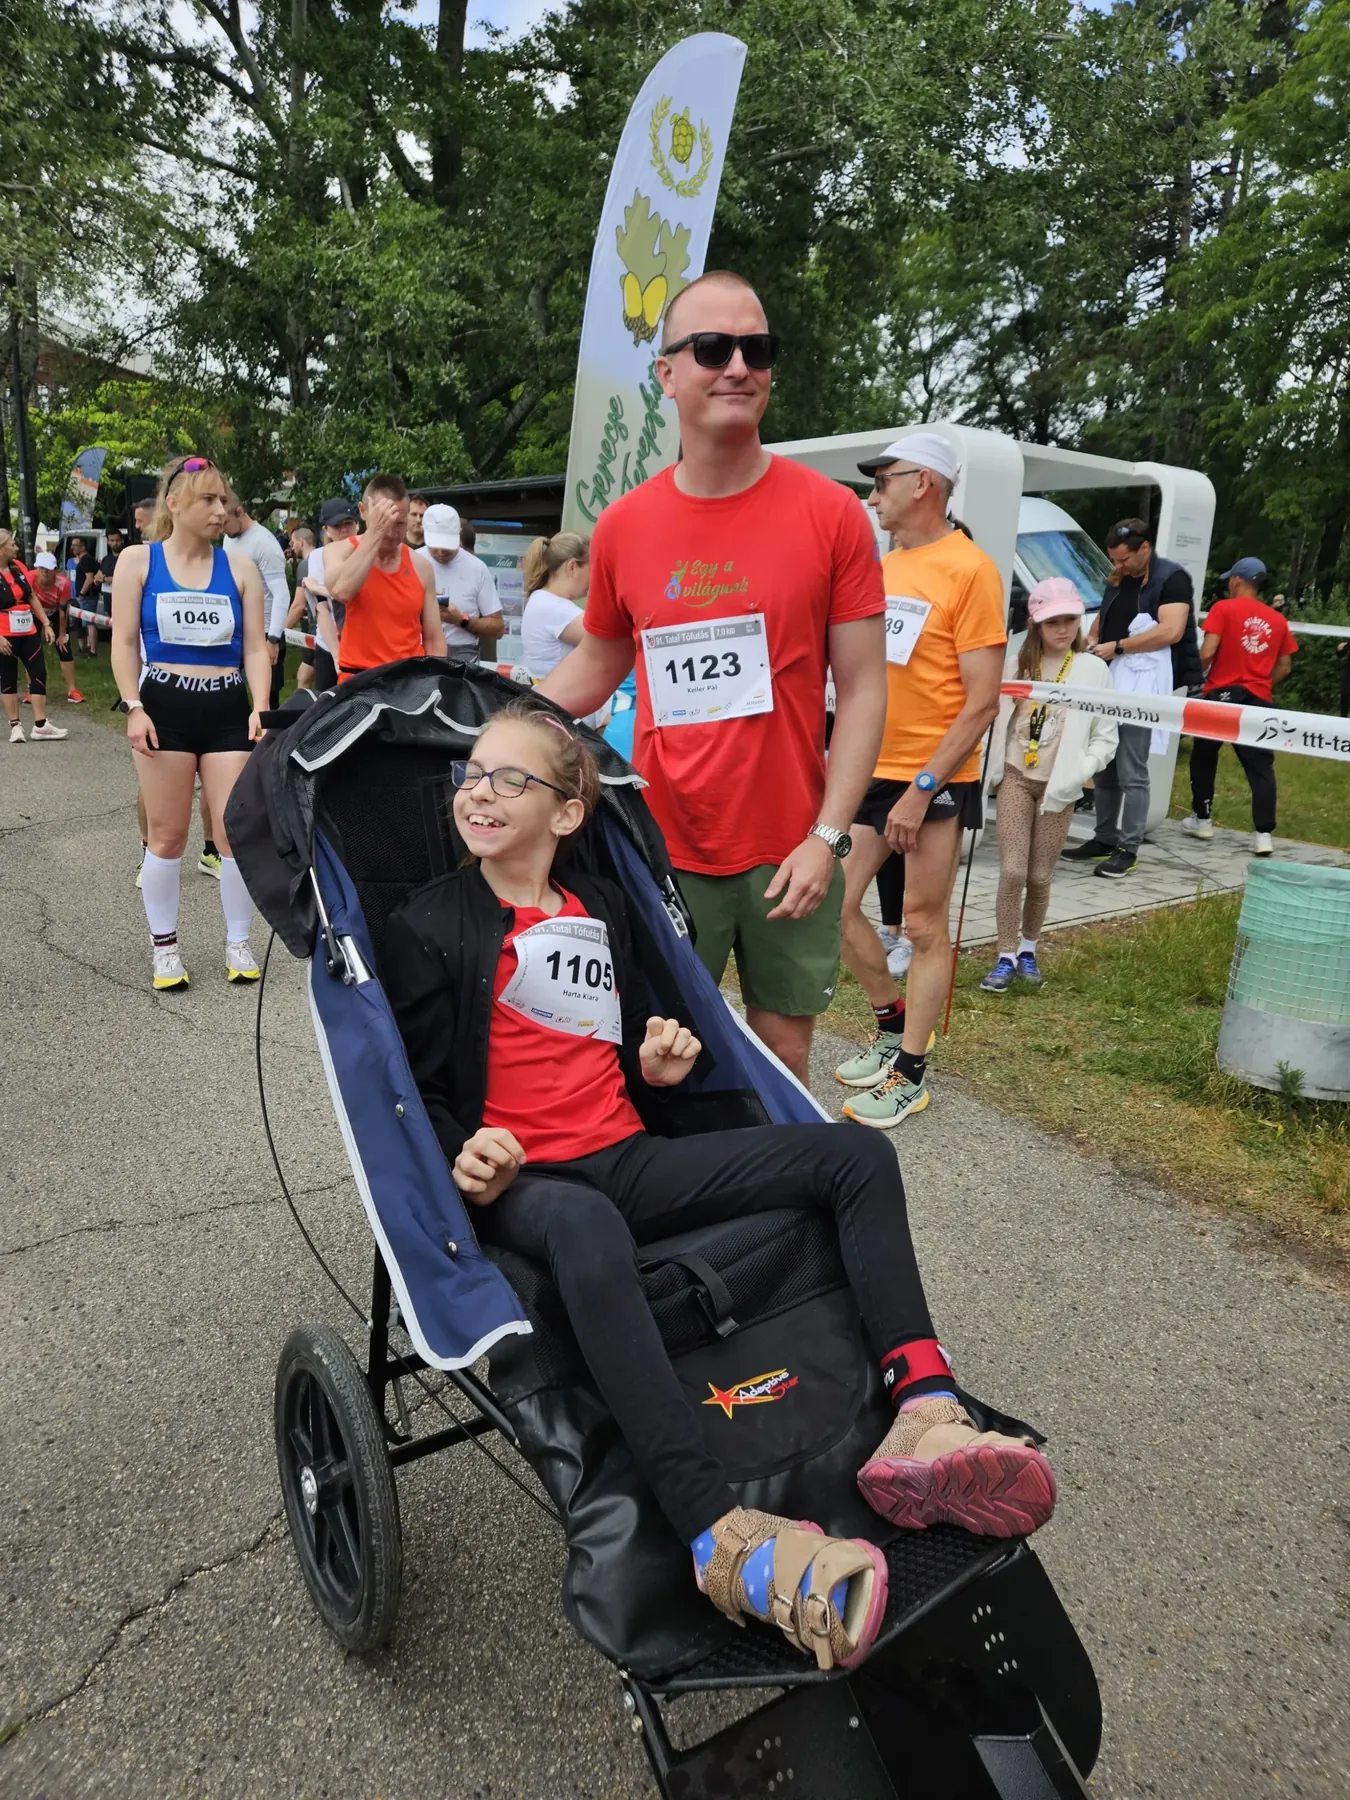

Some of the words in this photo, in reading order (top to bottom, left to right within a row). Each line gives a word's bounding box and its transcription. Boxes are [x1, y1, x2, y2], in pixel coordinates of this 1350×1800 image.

[620, 351, 666, 496] Terepfut
[575, 394, 629, 523] Gerecse
[690, 559, 719, 580] Egy
[172, 610, 220, 625] 1046
[654, 635, 666, 646] 91.
[148, 664, 171, 683] RO
[175, 676, 221, 692] NIKE
[223, 671, 242, 688] PR
[665, 651, 742, 684] 1123
[687, 686, 706, 694] Keller
[706, 684, 718, 692] Pál
[550, 924, 572, 934] Tatai
[573, 926, 600, 940] Tófutás
[546, 950, 613, 992] 1105
[563, 990, 581, 999] Harta
[582, 993, 599, 1002] Kiara
[739, 1371, 789, 1404] Adaptive
